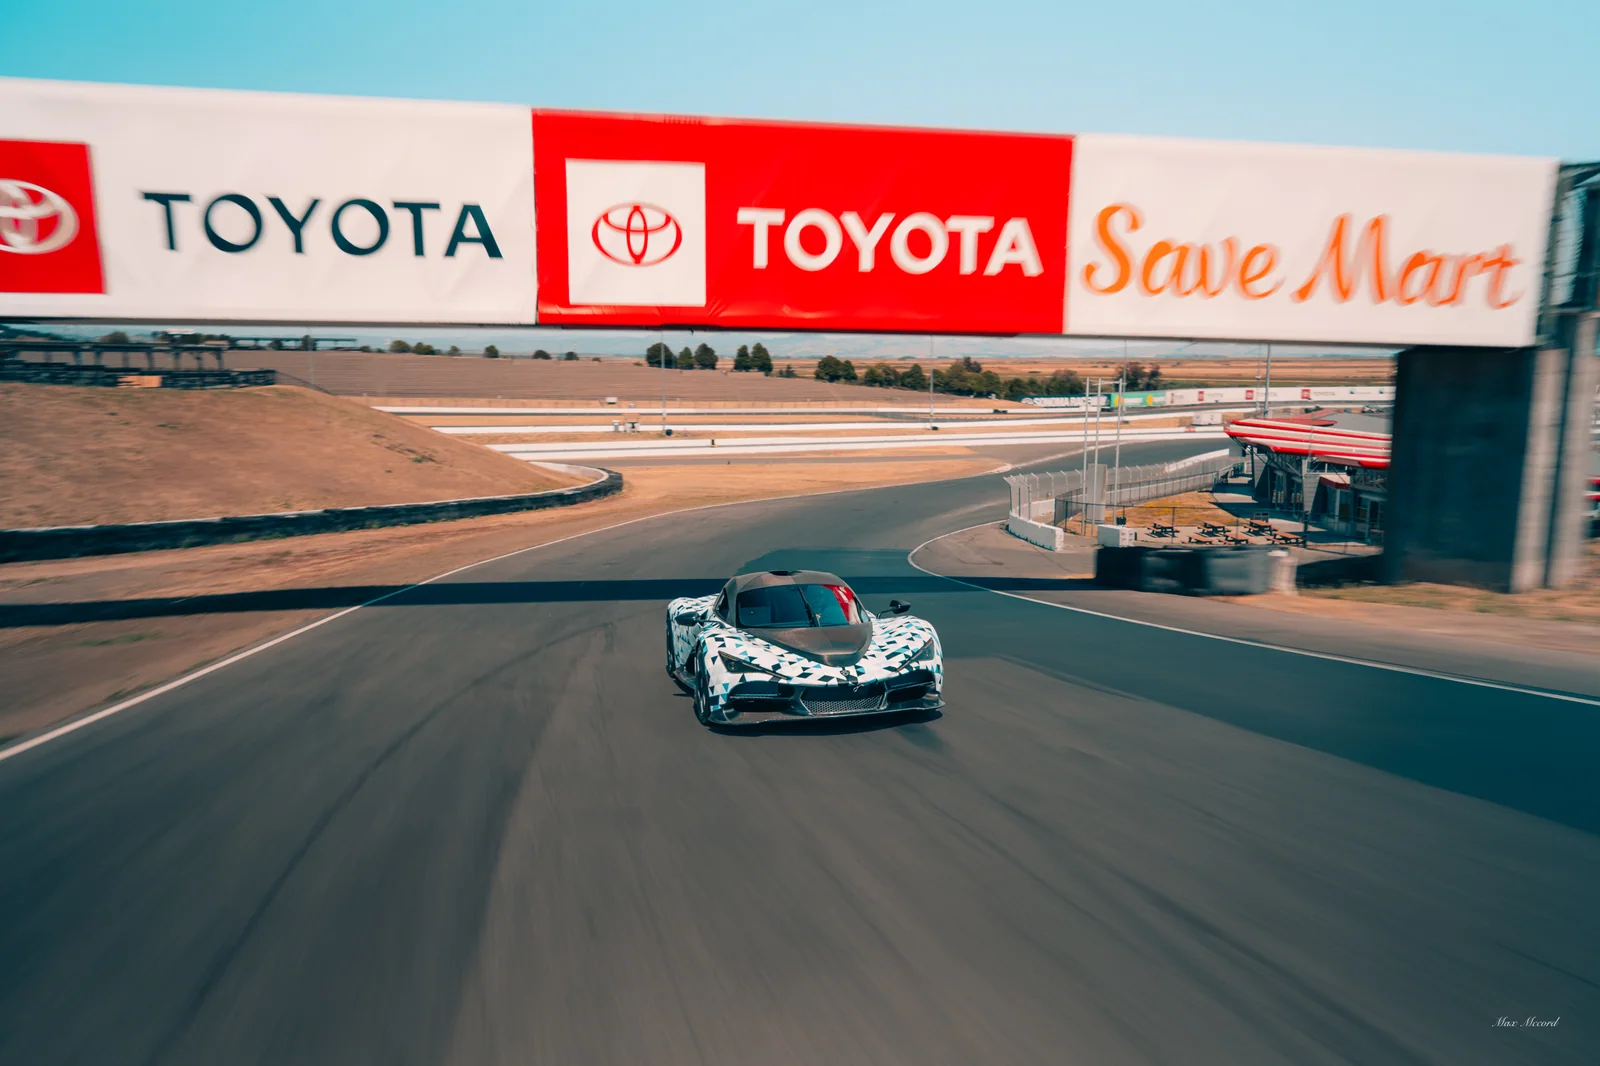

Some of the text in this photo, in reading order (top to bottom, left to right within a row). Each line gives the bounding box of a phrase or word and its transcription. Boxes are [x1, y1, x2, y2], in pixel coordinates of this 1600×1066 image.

[141, 192, 503, 259] TOYOTA
[737, 206, 1044, 277] TOYOTA
[1082, 203, 1523, 308] Save Mart
